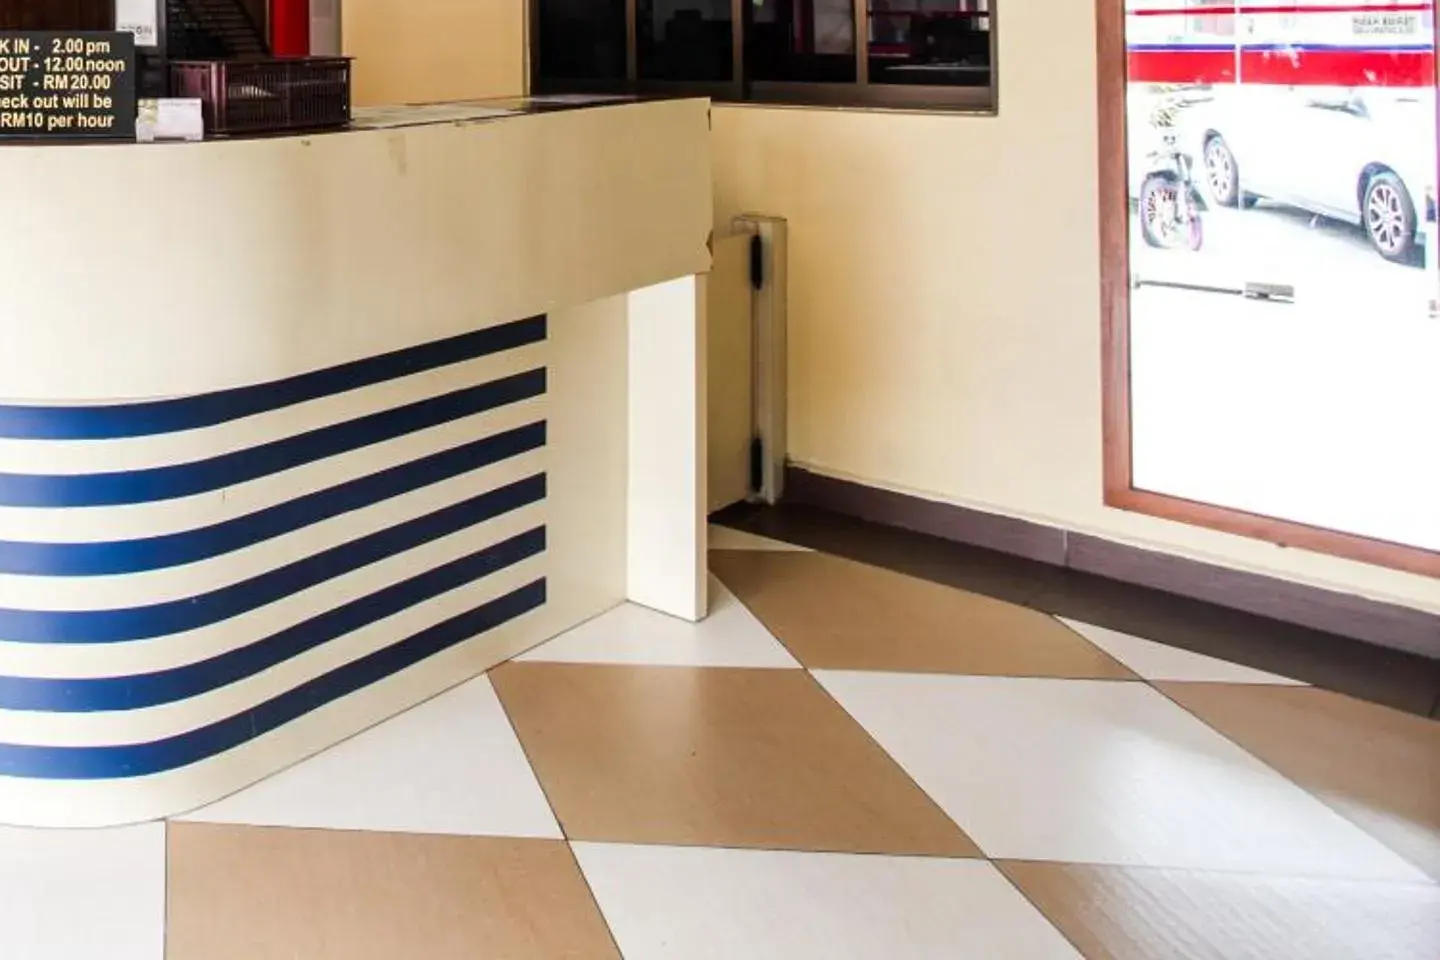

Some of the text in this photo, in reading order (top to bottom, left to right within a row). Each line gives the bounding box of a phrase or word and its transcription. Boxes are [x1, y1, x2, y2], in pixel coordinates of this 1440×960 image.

[14, 38, 30, 54] IN
[52, 38, 83, 54] 2.00
[85, 41, 110, 57] pm
[44, 57, 83, 72] 12.00
[85, 59, 126, 72] noon
[43, 75, 68, 90] RM
[71, 75, 110, 90] 20.00
[33, 95, 59, 109] out
[62, 93, 89, 109] will
[93, 93, 112, 109] be
[0, 113, 43, 128] RM10
[47, 116, 73, 131] per
[77, 113, 115, 128] hour
